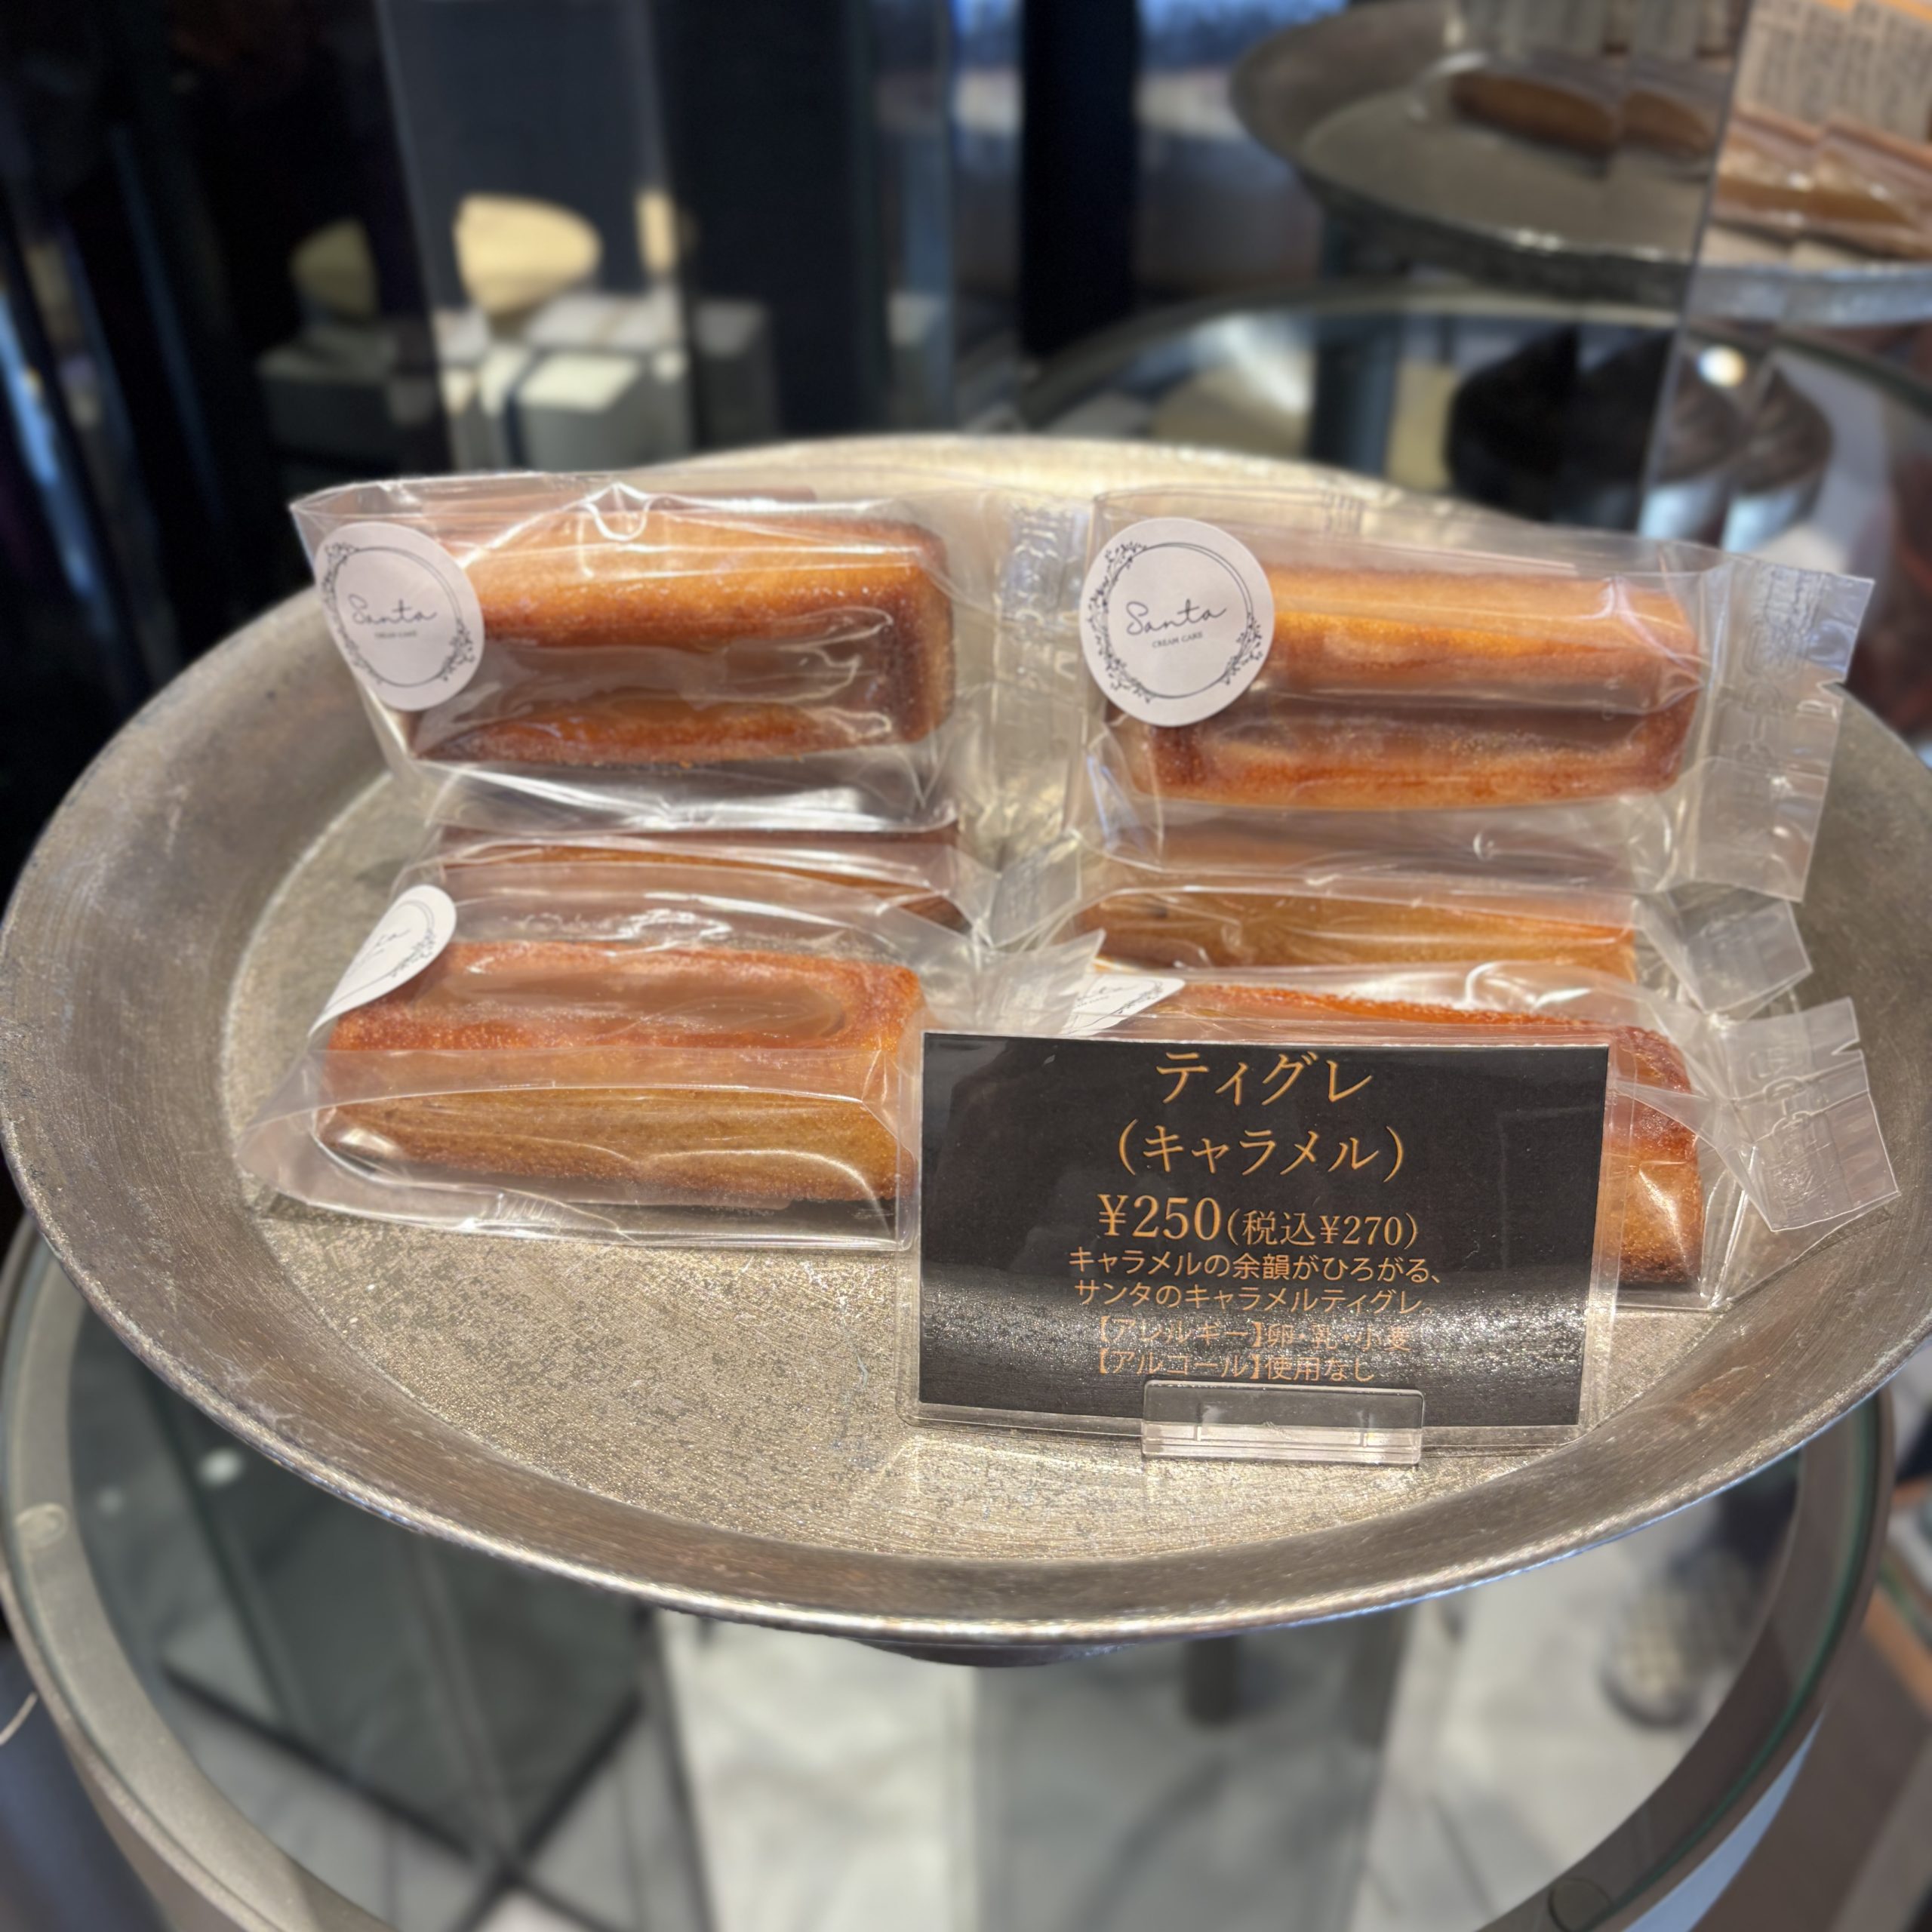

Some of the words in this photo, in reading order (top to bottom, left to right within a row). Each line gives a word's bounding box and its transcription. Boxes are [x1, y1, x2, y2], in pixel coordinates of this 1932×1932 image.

[348, 594, 438, 625] Santa
[1126, 598, 1226, 635] Santa
[1152, 637, 1180, 649] CREAM
[1155, 1051, 1374, 1106] ティグレ
[1118, 1118, 1404, 1183] (キャラメル)
[1069, 1246, 1441, 1284] キャラメルの余韻がひろがる、
[1075, 1280, 1432, 1315] サンタのキャラメルティグレ。
[1099, 1348, 1376, 1383] 【アルコール】使用なし
